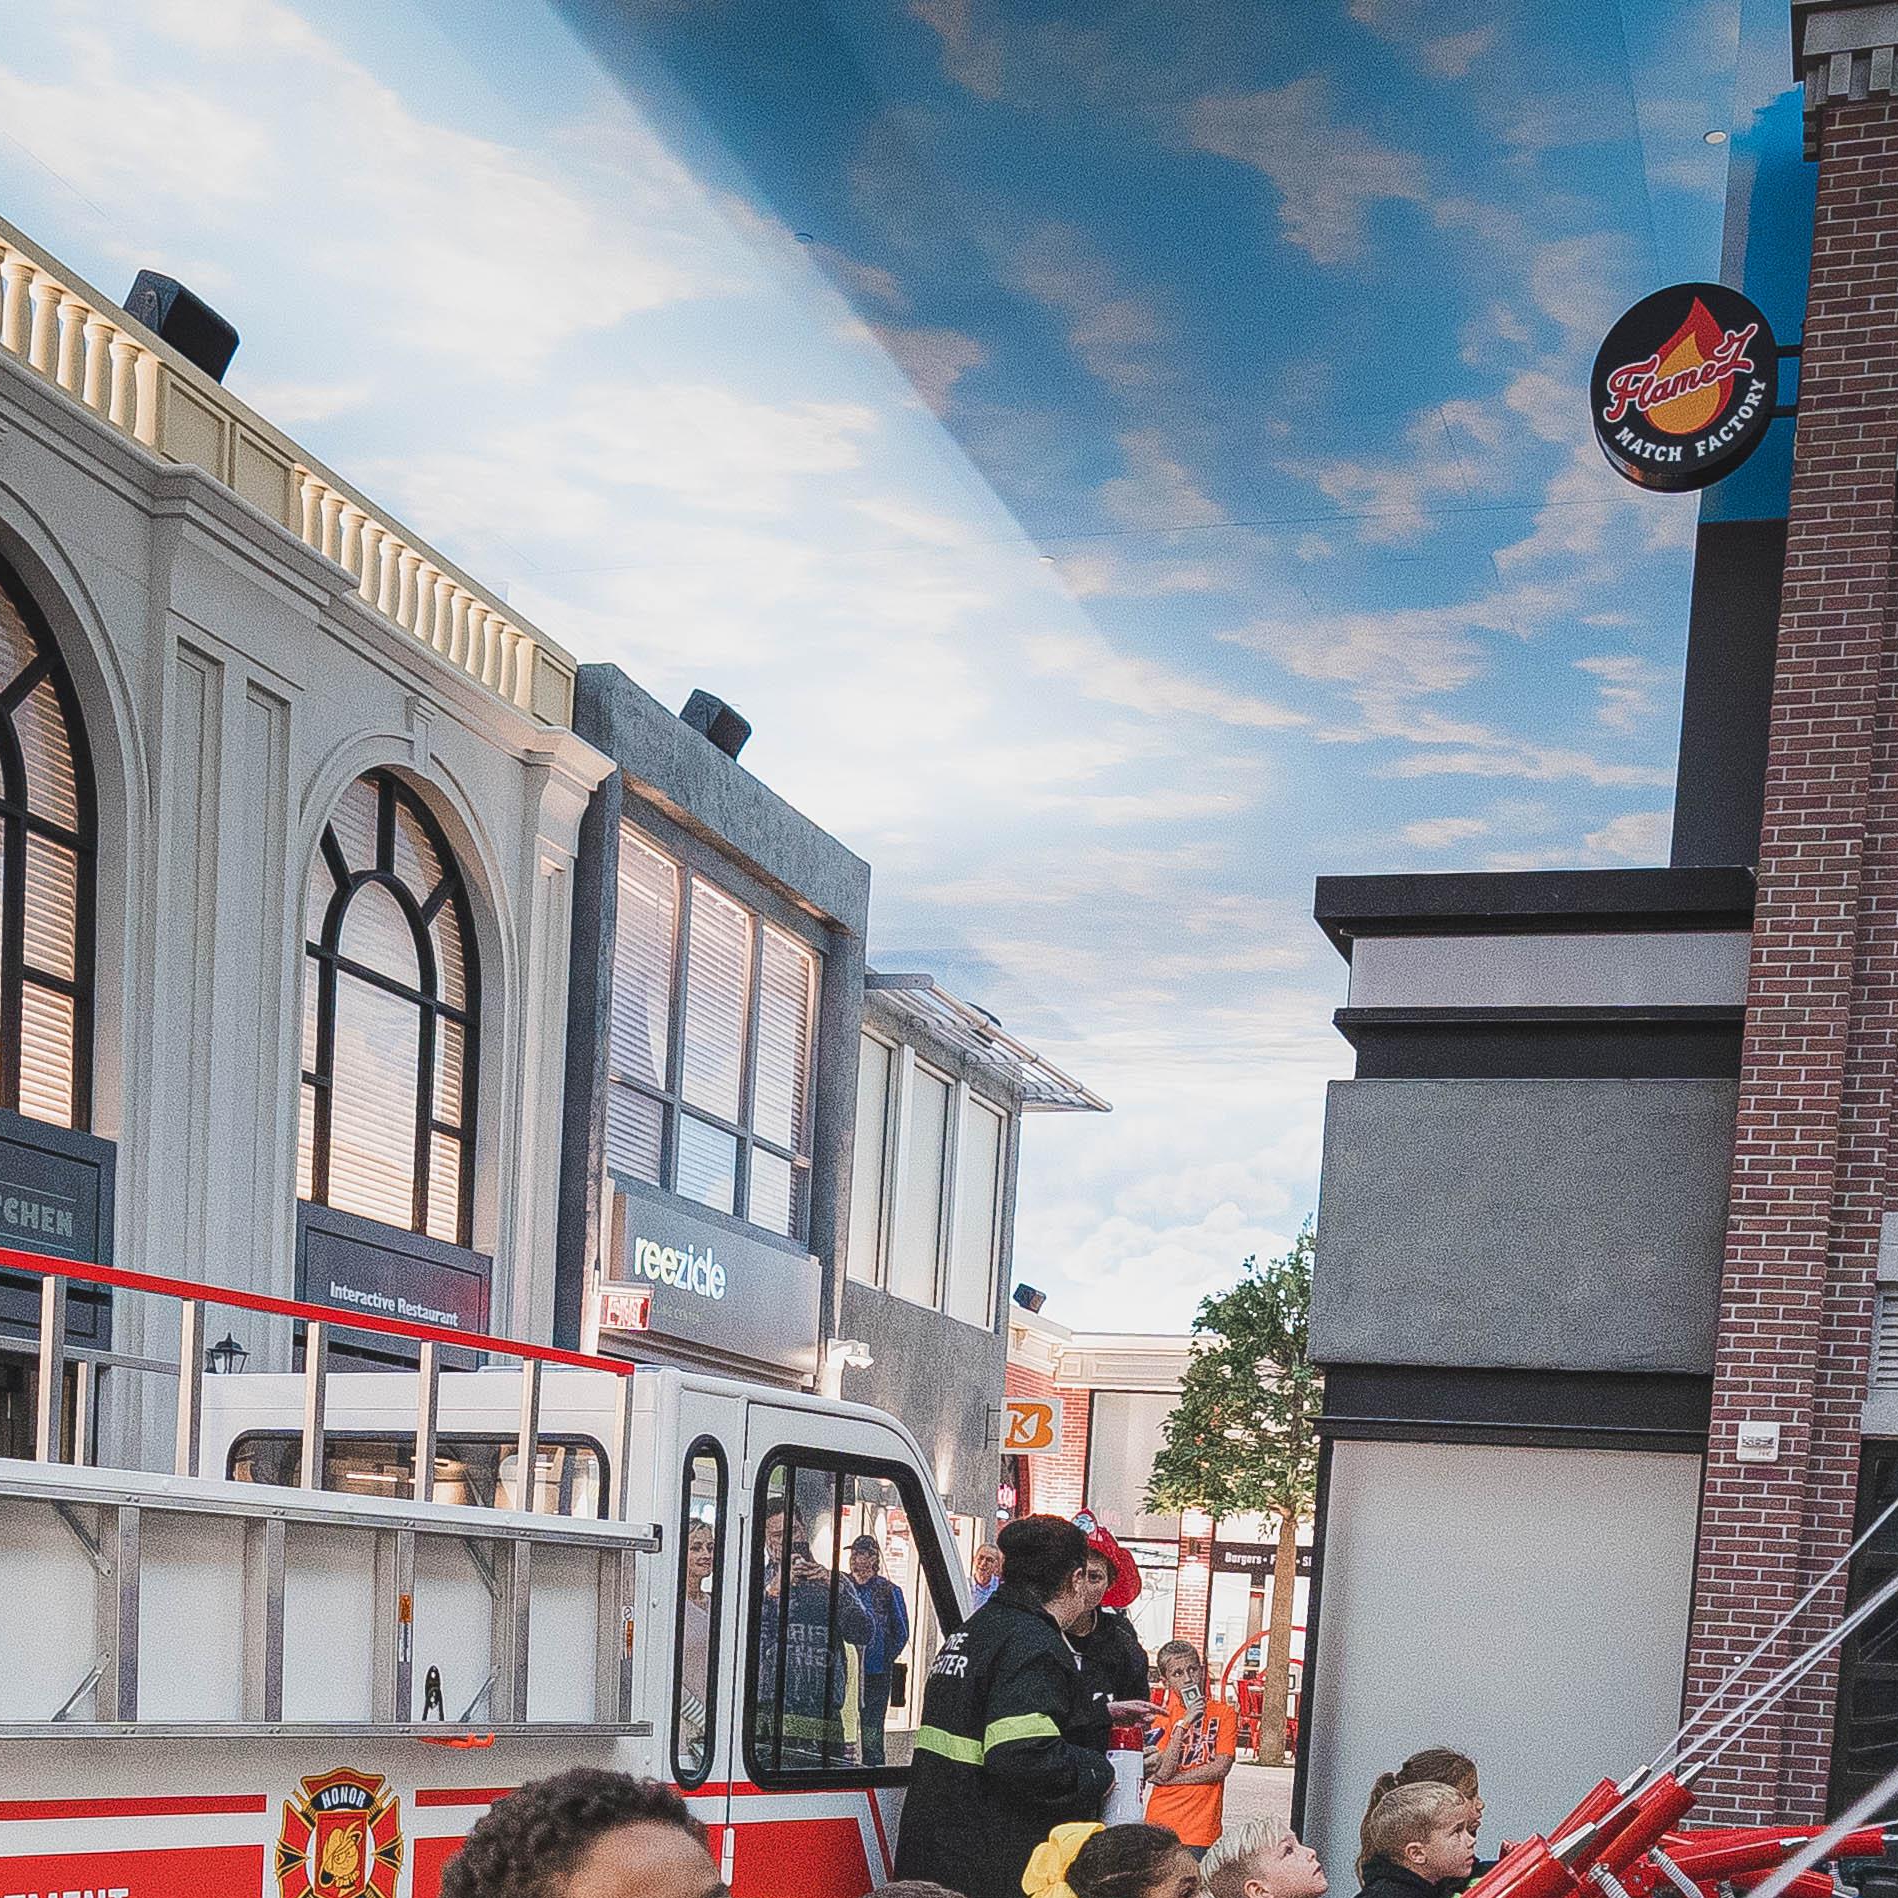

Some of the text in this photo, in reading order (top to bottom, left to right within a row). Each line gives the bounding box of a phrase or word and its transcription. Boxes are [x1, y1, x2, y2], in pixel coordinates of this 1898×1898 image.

[1614, 378, 1766, 462] MATCH FACTORY
[330, 1281, 459, 1327] Interactive Restaurant
[321, 1786, 366, 1809] HONOR
